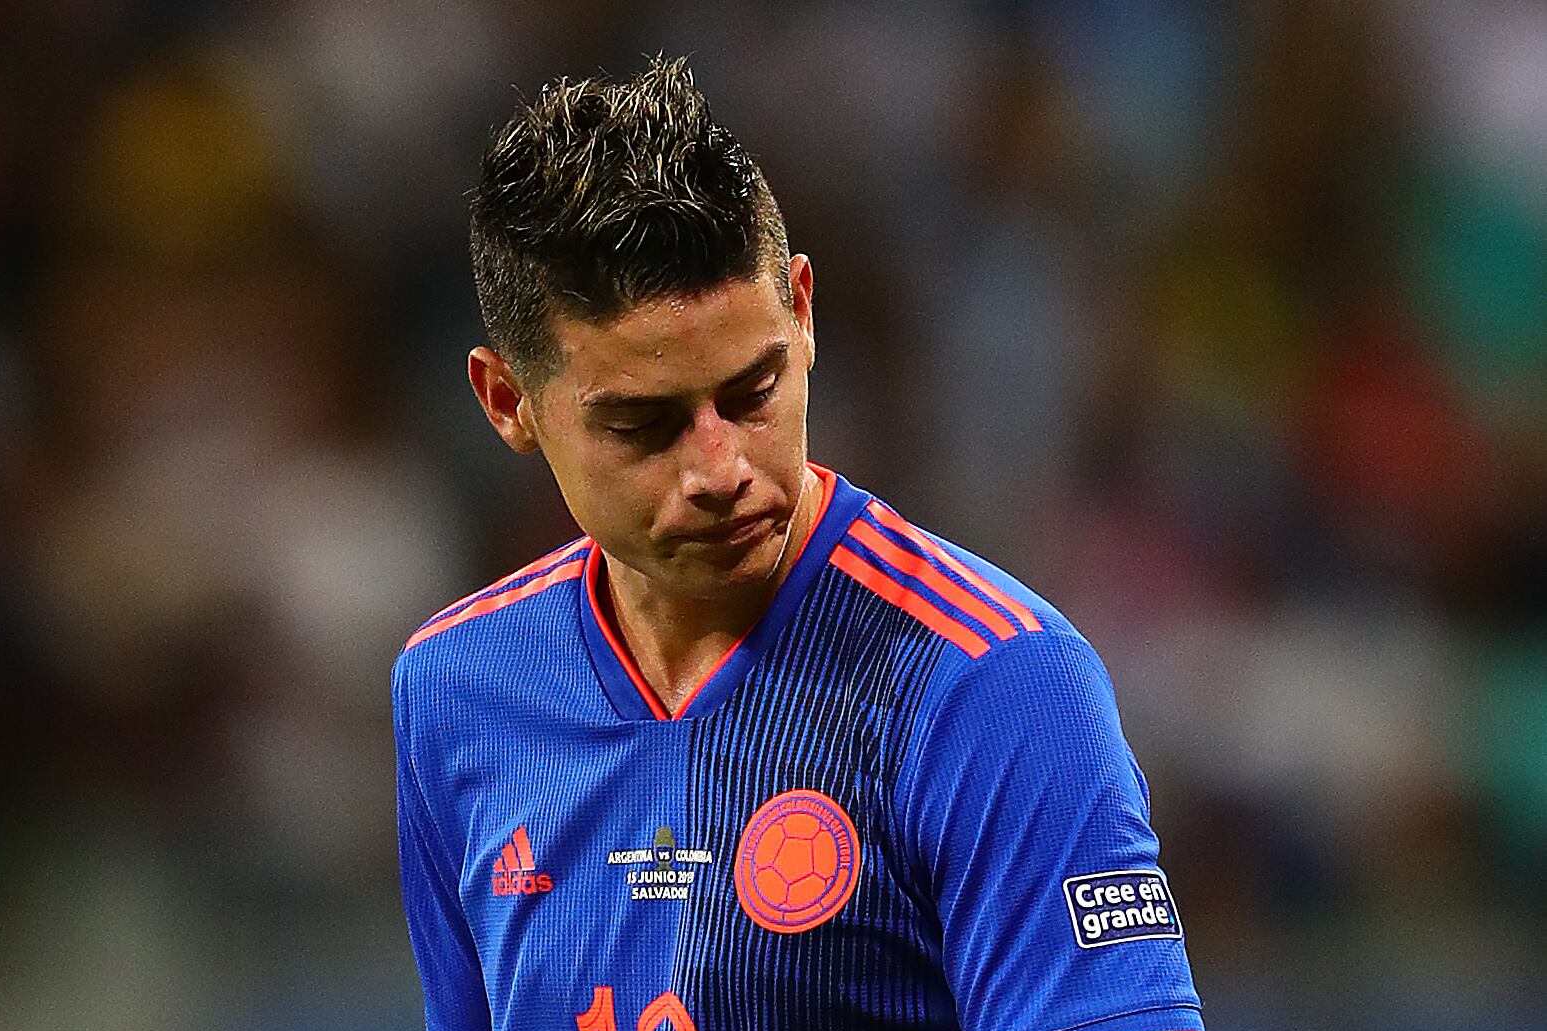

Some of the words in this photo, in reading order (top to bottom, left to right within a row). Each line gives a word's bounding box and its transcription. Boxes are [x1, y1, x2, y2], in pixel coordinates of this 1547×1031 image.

[608, 850, 653, 864] ARGENTINA
[627, 871, 637, 884] 15
[638, 871, 676, 883] JUNIO
[1075, 884, 1136, 908] Cree
[1138, 883, 1166, 900] en
[1082, 901, 1169, 938] grande
